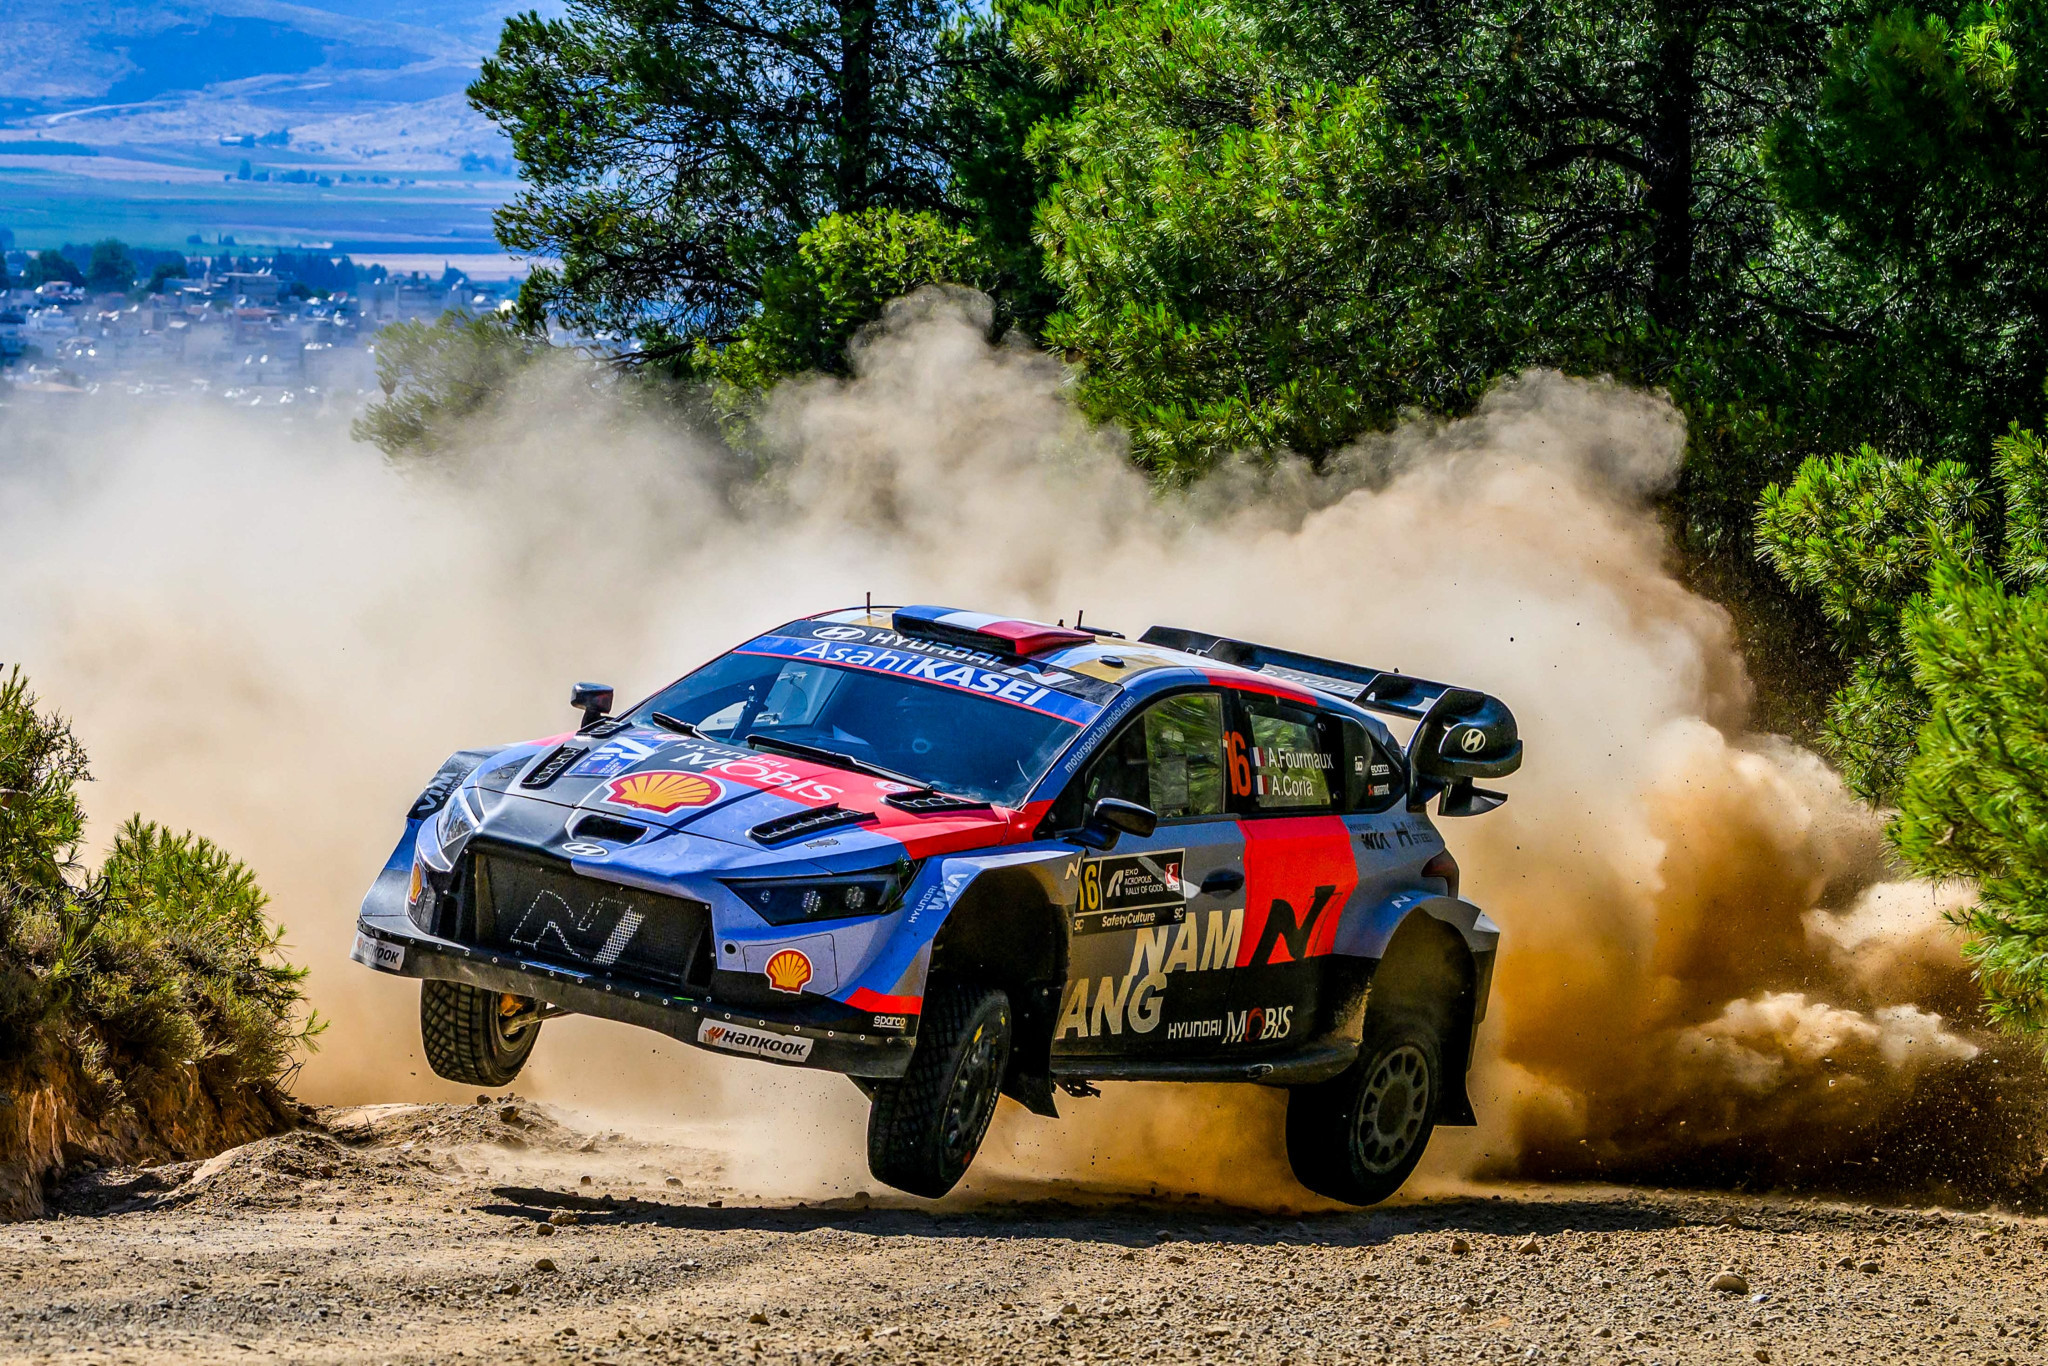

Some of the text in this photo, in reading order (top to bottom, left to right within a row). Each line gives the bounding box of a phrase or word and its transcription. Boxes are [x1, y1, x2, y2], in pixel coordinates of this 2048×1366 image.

[869, 631, 1004, 667] HYUNDAI
[796, 641, 1052, 706] AsahiKASEI
[1064, 695, 1136, 773] motorsport.hyundai.com
[675, 742, 791, 769] HYUNDAI
[1222, 730, 1252, 797] 16
[669, 751, 844, 800] MOBIS
[1360, 829, 1392, 850] WIA
[1411, 833, 1433, 844] STEEL
[1078, 864, 1099, 911] 16
[1124, 874, 1152, 886] ACROPOLIS
[1125, 867, 1139, 877] EKO
[1125, 883, 1164, 896] RALLY OF GODS
[908, 885, 938, 923] HYUNDAI
[926, 873, 970, 910] WIA
[1074, 918, 1085, 931] SC
[1174, 907, 1184, 919] SC
[873, 1014, 906, 1028] sparco
[1055, 971, 1168, 1041] ANG
[1168, 1005, 1294, 1044] HYUNDAI MOBIS
